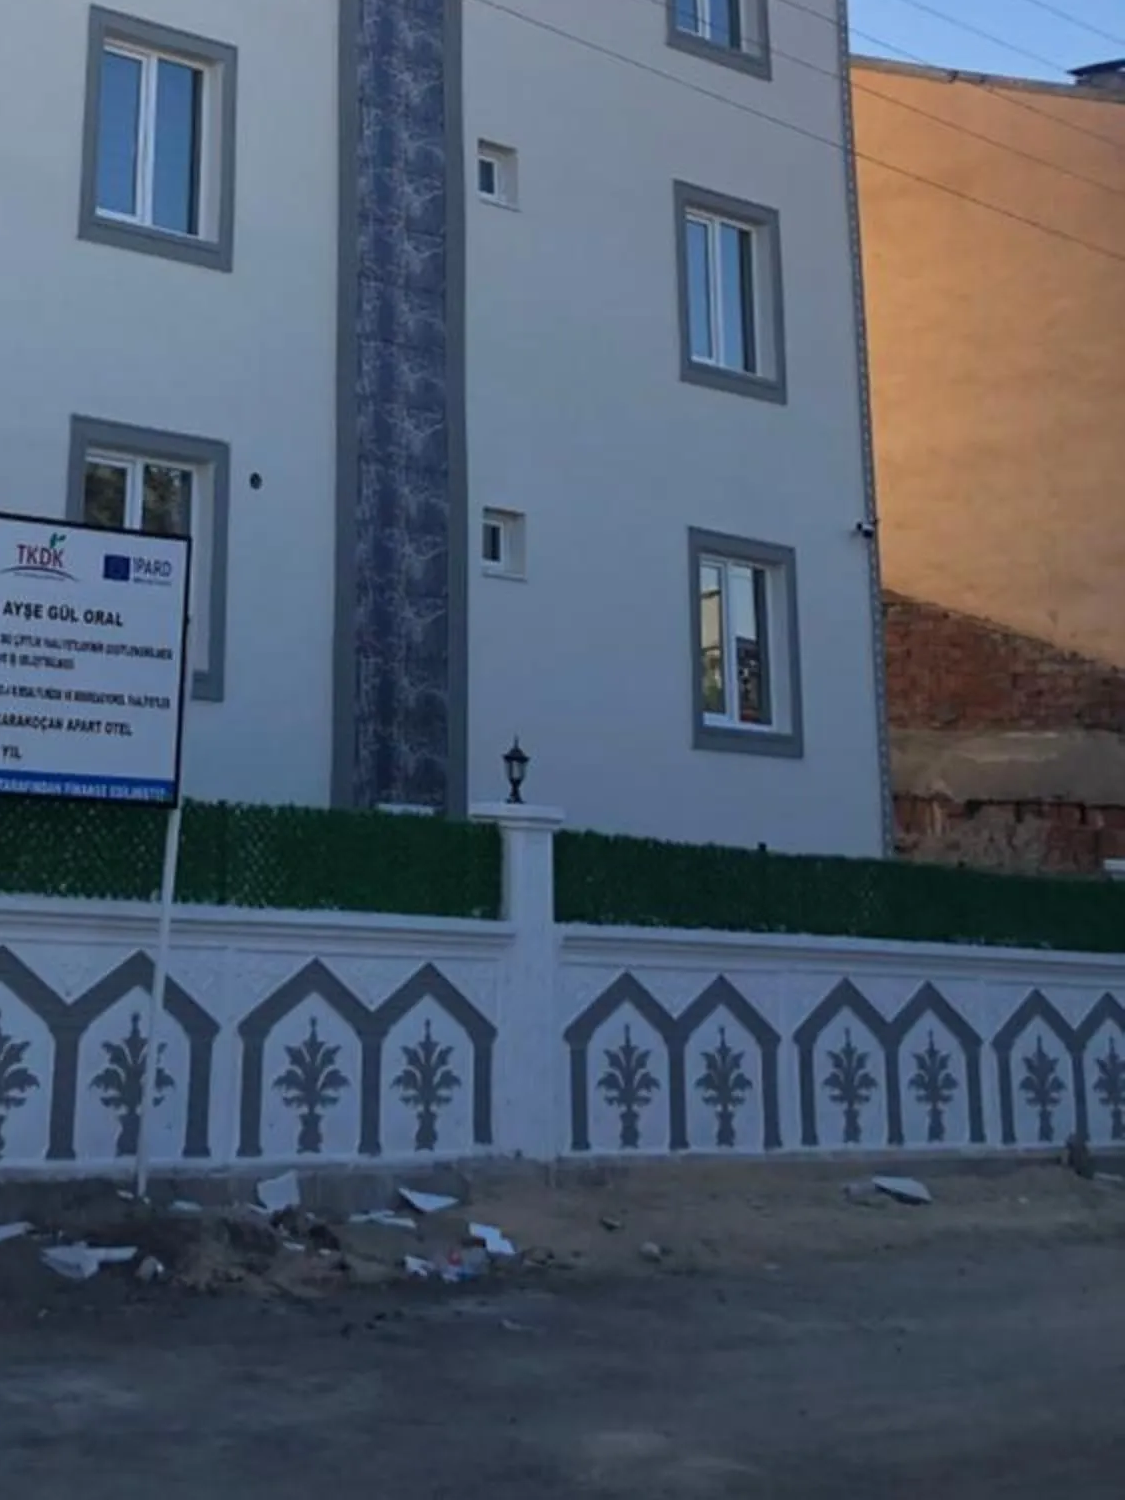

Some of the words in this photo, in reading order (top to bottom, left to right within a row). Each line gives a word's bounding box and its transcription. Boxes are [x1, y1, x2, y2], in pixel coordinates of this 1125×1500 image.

[17, 544, 64, 567] TKDK
[2, 601, 43, 620] AYŞE
[47, 604, 79, 623] GÜL
[83, 609, 123, 627] ORAL
[66, 718, 102, 734] APART
[104, 721, 133, 737] OTEL
[2, 745, 22, 760] YIL
